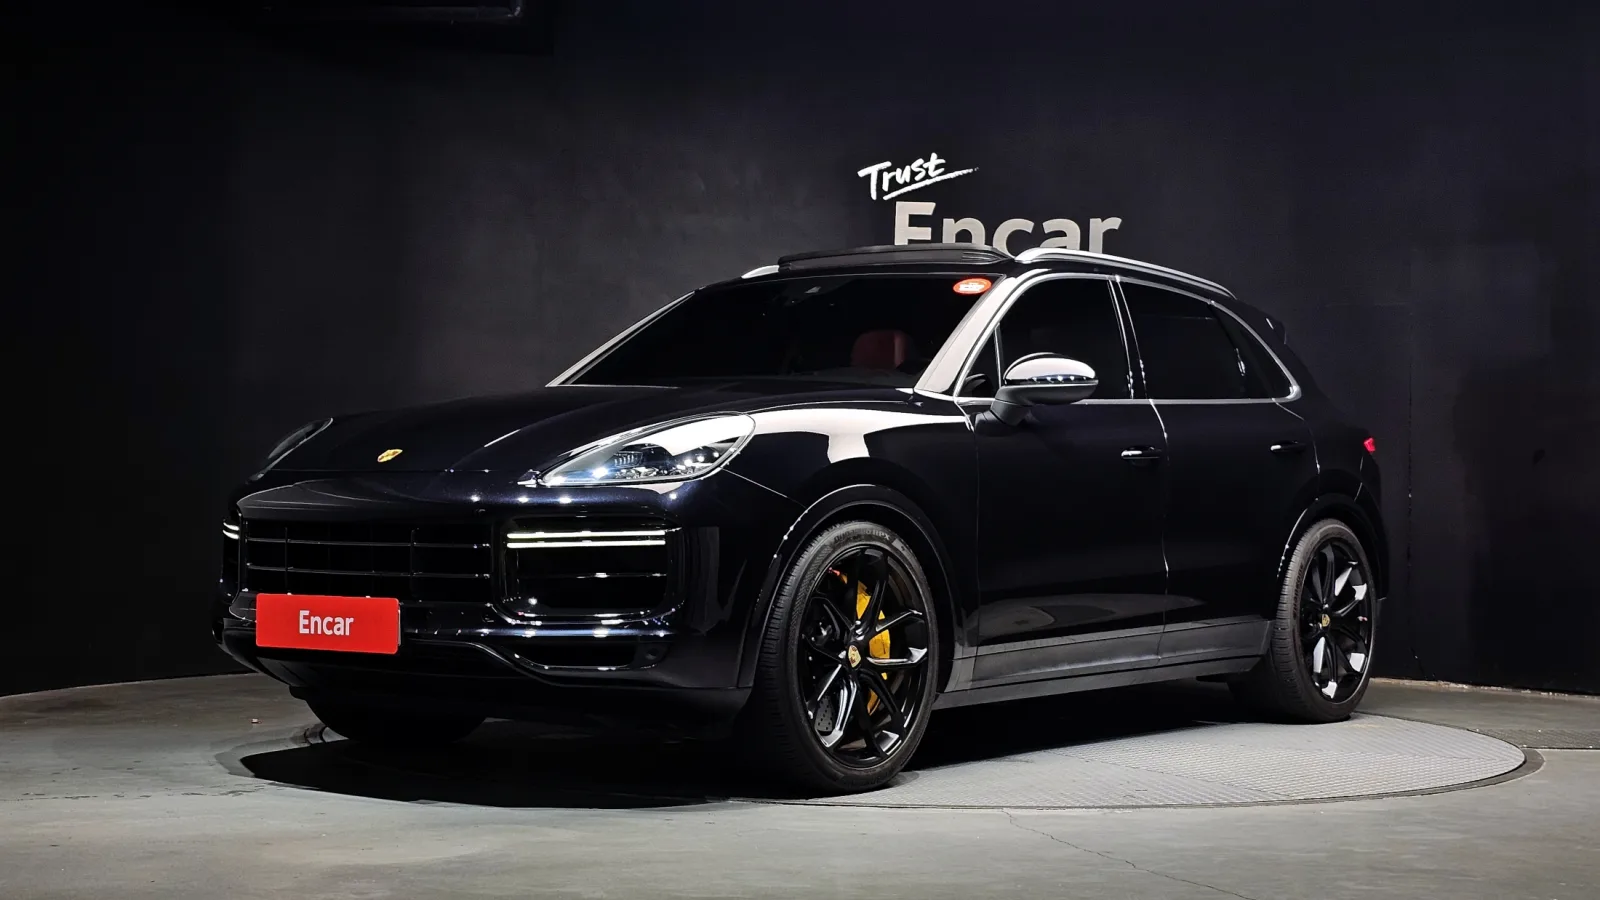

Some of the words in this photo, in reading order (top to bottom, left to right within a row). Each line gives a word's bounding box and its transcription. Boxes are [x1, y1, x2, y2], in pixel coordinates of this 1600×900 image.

[857, 152, 947, 200] Trust
[894, 201, 1122, 258] Encar
[298, 609, 354, 636] Encar
